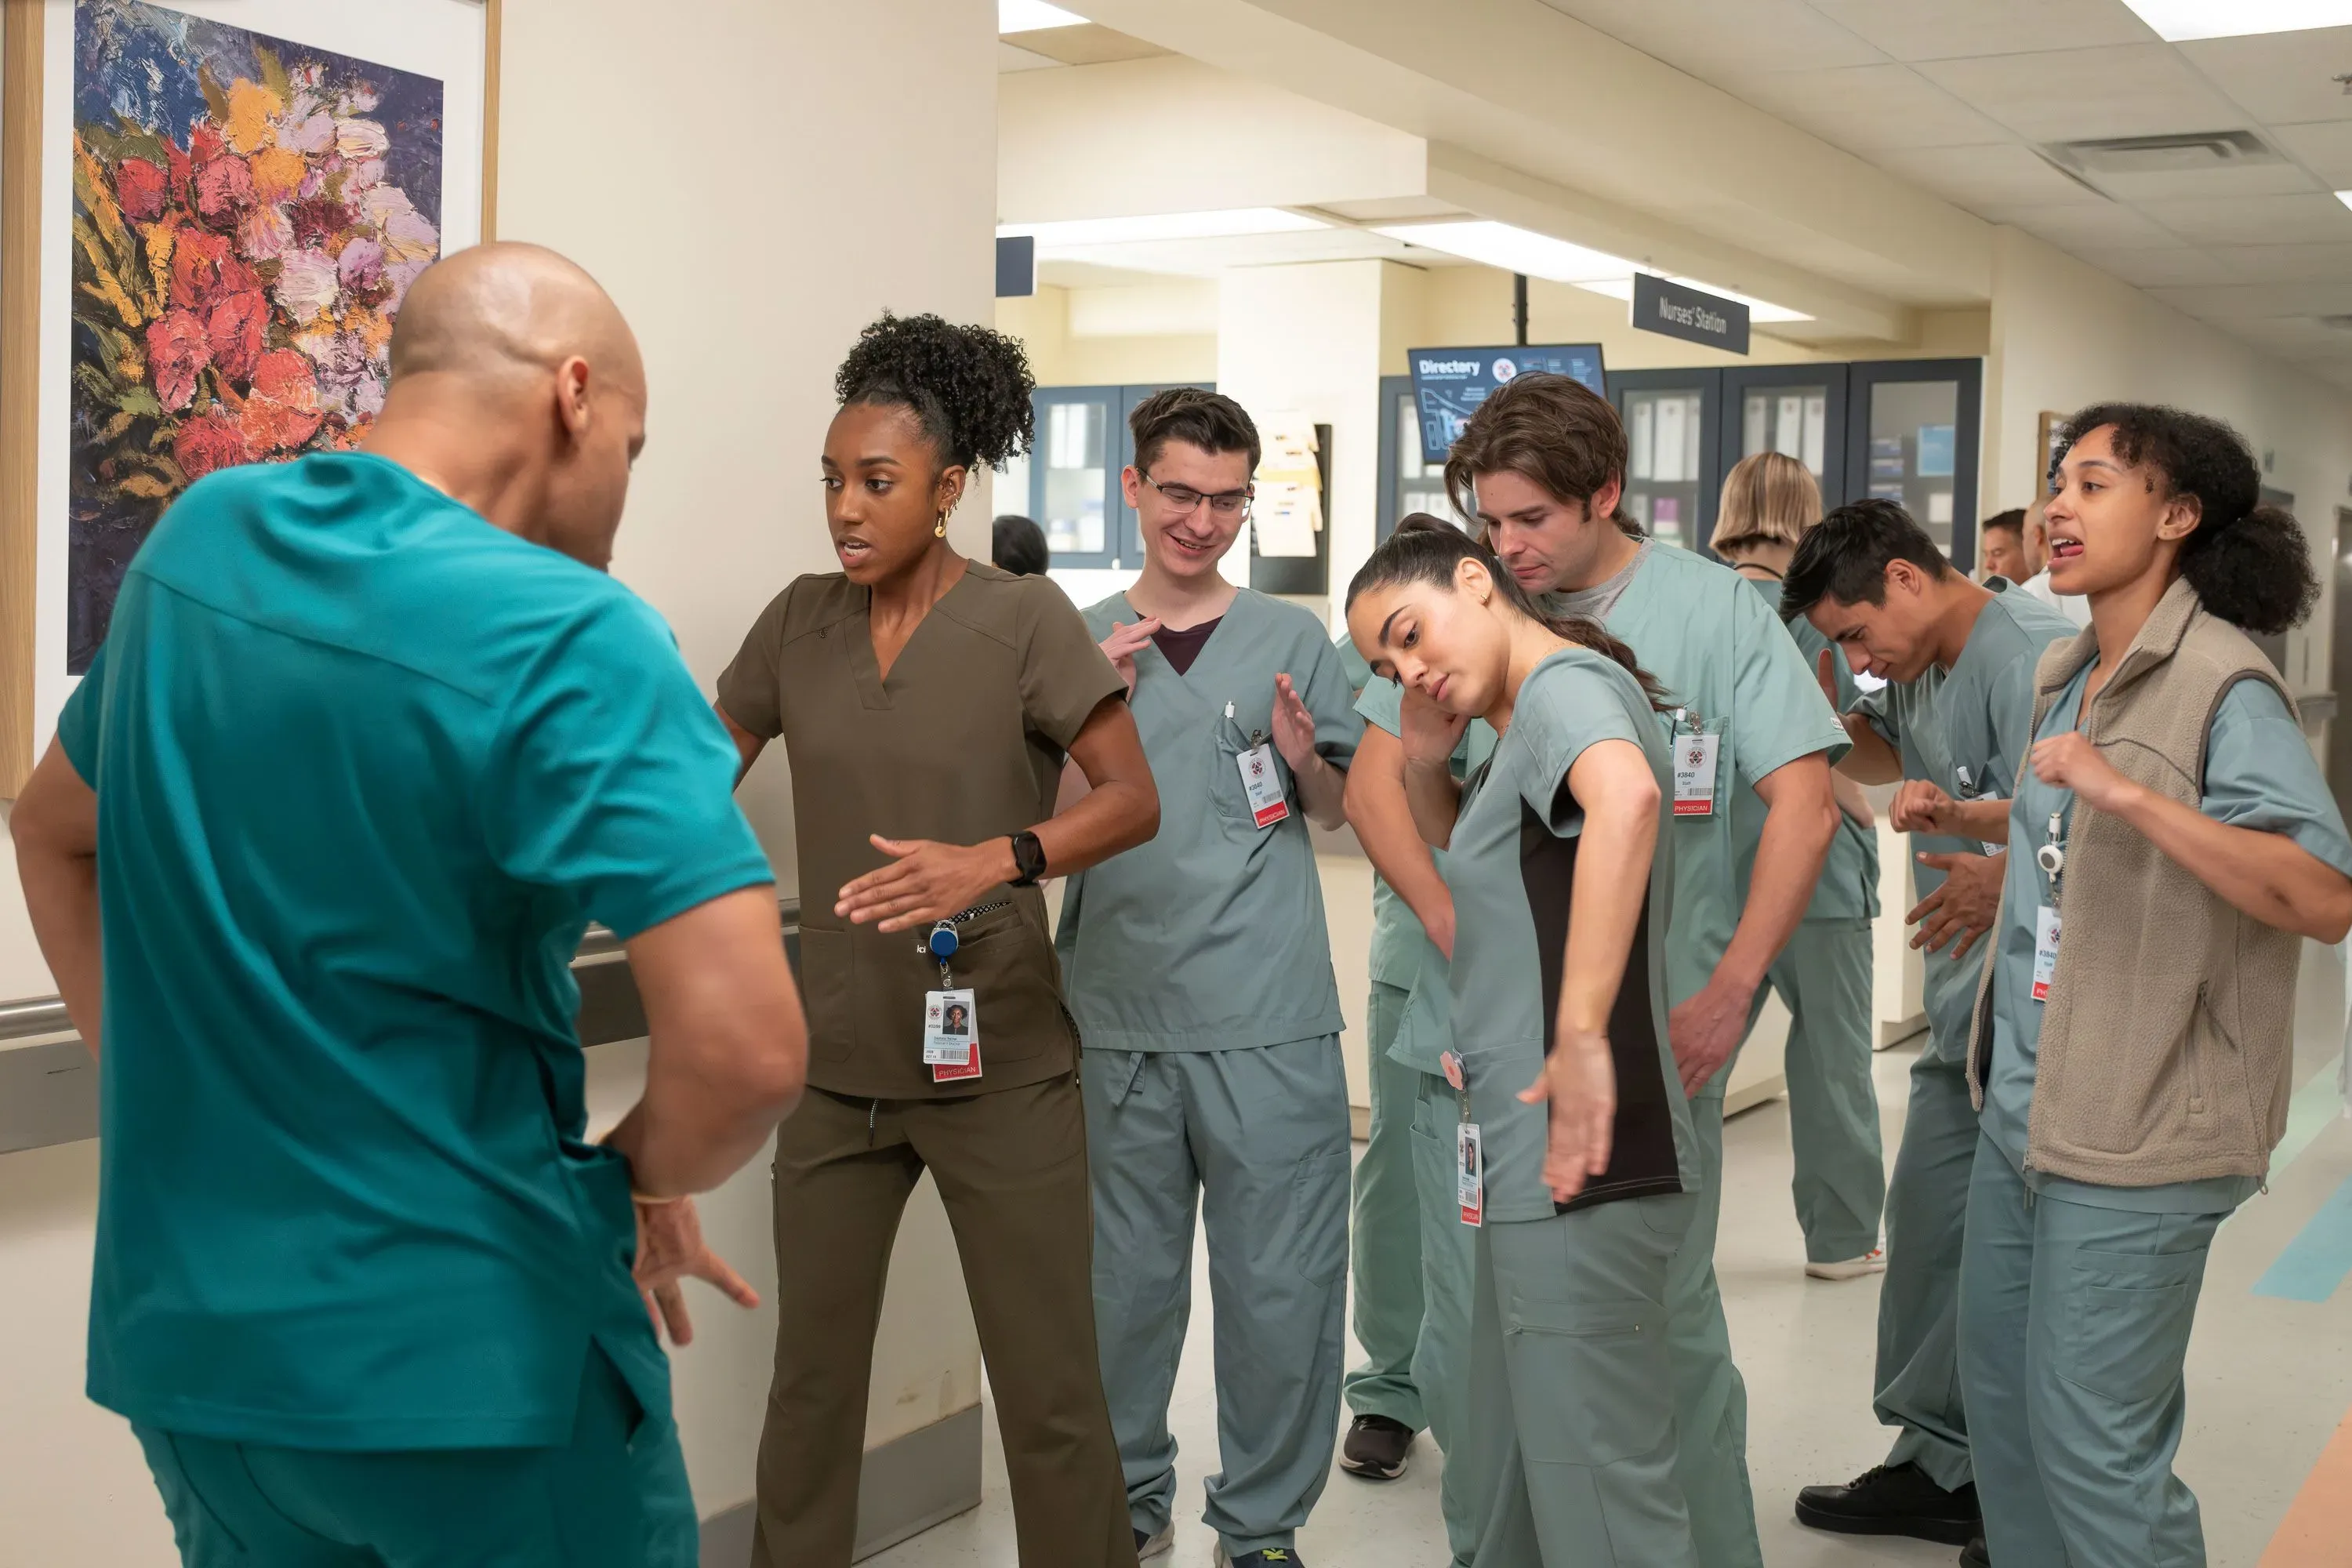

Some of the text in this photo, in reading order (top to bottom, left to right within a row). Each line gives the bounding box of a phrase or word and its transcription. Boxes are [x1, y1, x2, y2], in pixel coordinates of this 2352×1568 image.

[1659, 296, 1727, 334] Nurses' Station
[1418, 359, 1480, 376] Directory
[938, 1066, 976, 1076] PHYSICIAN
